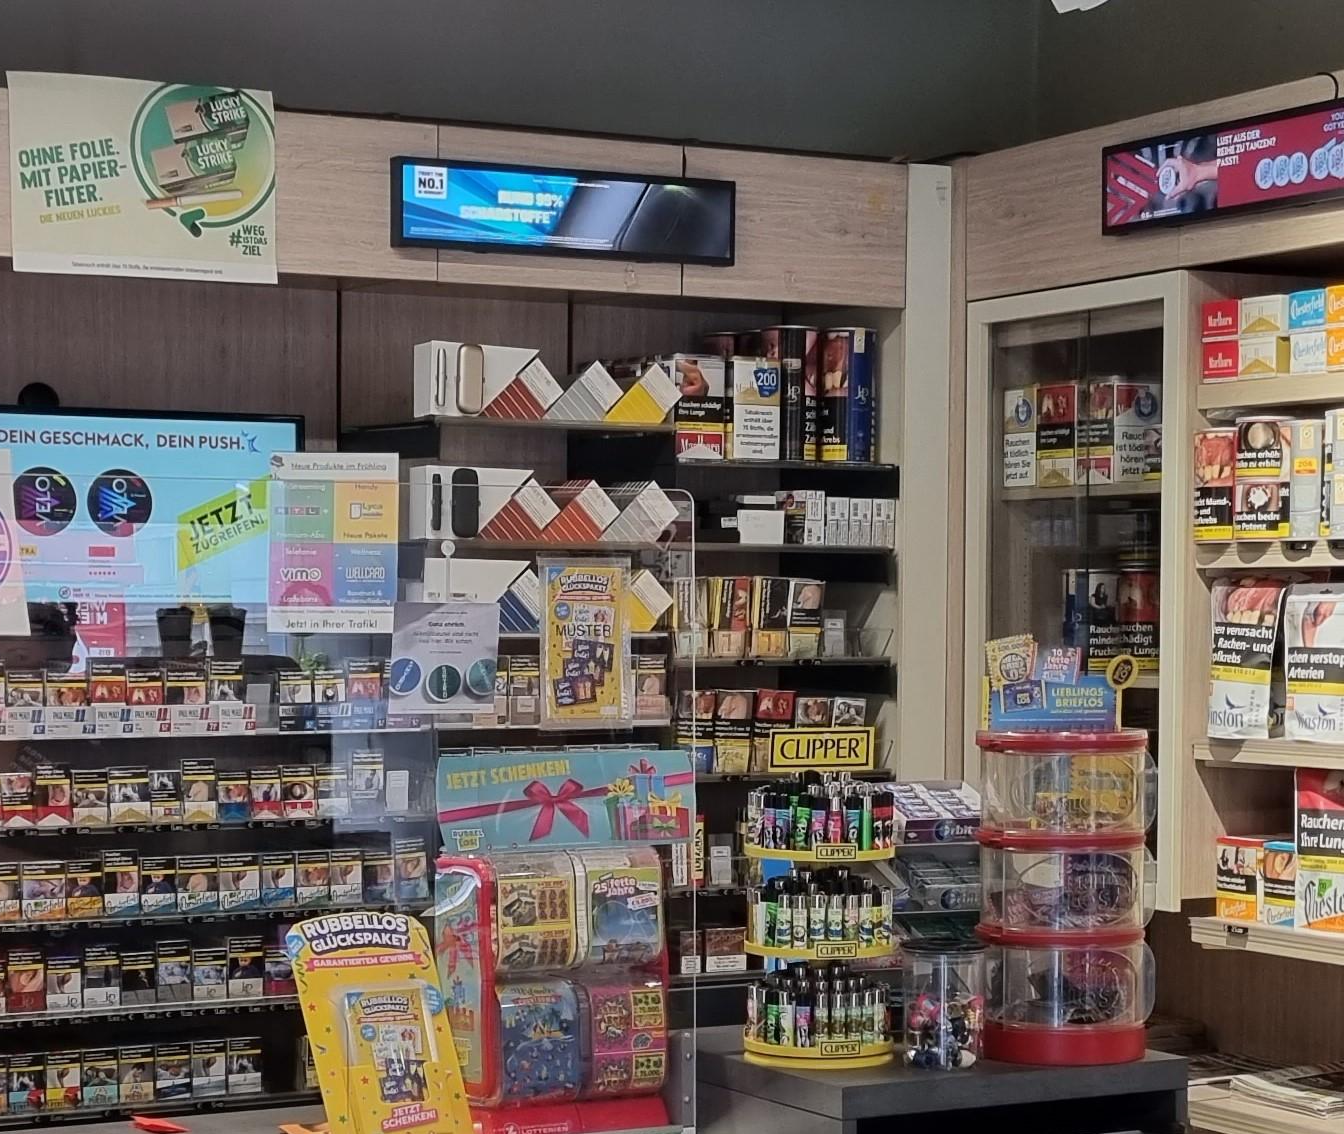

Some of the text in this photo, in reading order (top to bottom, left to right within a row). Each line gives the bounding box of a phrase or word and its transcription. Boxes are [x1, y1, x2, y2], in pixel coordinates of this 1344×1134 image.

[211, 95, 241, 112] LUCKY
[212, 107, 247, 125] STRIKE
[19, 138, 120, 168] OHNE FOLIE.
[197, 139, 229, 156] LUCKY
[198, 151, 233, 170] STRIKE
[1217, 156, 1239, 167] PASST!
[20, 159, 127, 189] MIT PAPIER-
[45, 184, 103, 208] FILTER.
[1207, 312, 1233, 326] Marlboro
[1208, 352, 1232, 368] Marlboro
[758, 372, 777, 386] 200
[39, 431, 150, 450] GESCHMACK,
[156, 434, 194, 449] DEIN
[199, 436, 245, 450] PUSH.
[189, 493, 255, 542] JETZT
[280, 567, 321, 582] vimo
[285, 619, 377, 629] Jetzt Ihrer Trafik!
[556, 624, 611, 637] MUSTER
[1226, 626, 1273, 641] verursacht
[1288, 667, 1325, 680] Arterien
[1051, 687, 1107, 697] LIEBLINGS-
[1056, 696, 1104, 707] BRIEFLOS
[780, 738, 861, 760] CLIPPER
[446, 759, 571, 790] JETZT SCHENKEN!
[1300, 833, 1318, 847] Ihre
[819, 848, 853, 857] CLIPPER
[303, 914, 407, 939] RUBBELLOS
[310, 929, 409, 953] GLÜCKSPAKET
[820, 946, 853, 955] CLIPPER
[824, 1044, 857, 1054] CLIPPER
[393, 1105, 421, 1119] JETZT
[383, 1110, 436, 1130] SCHENKEN!
